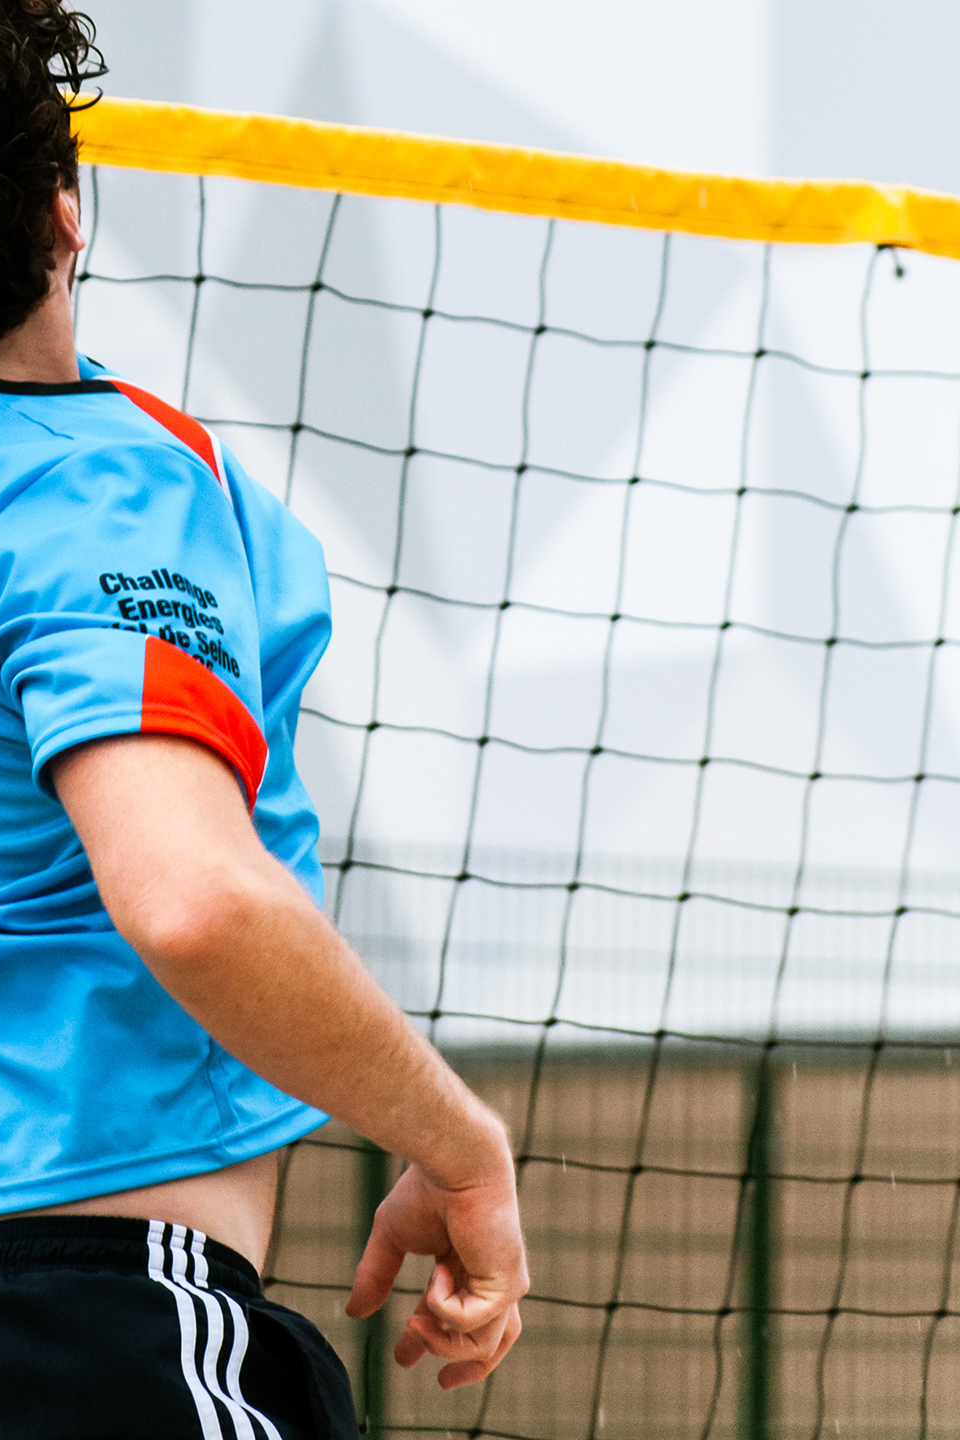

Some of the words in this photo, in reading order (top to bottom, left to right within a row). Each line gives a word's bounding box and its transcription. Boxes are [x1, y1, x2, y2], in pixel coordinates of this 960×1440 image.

[98, 568, 218, 609] Challenge
[117, 597, 224, 635] Energies
[194, 630, 240, 678] Seine
